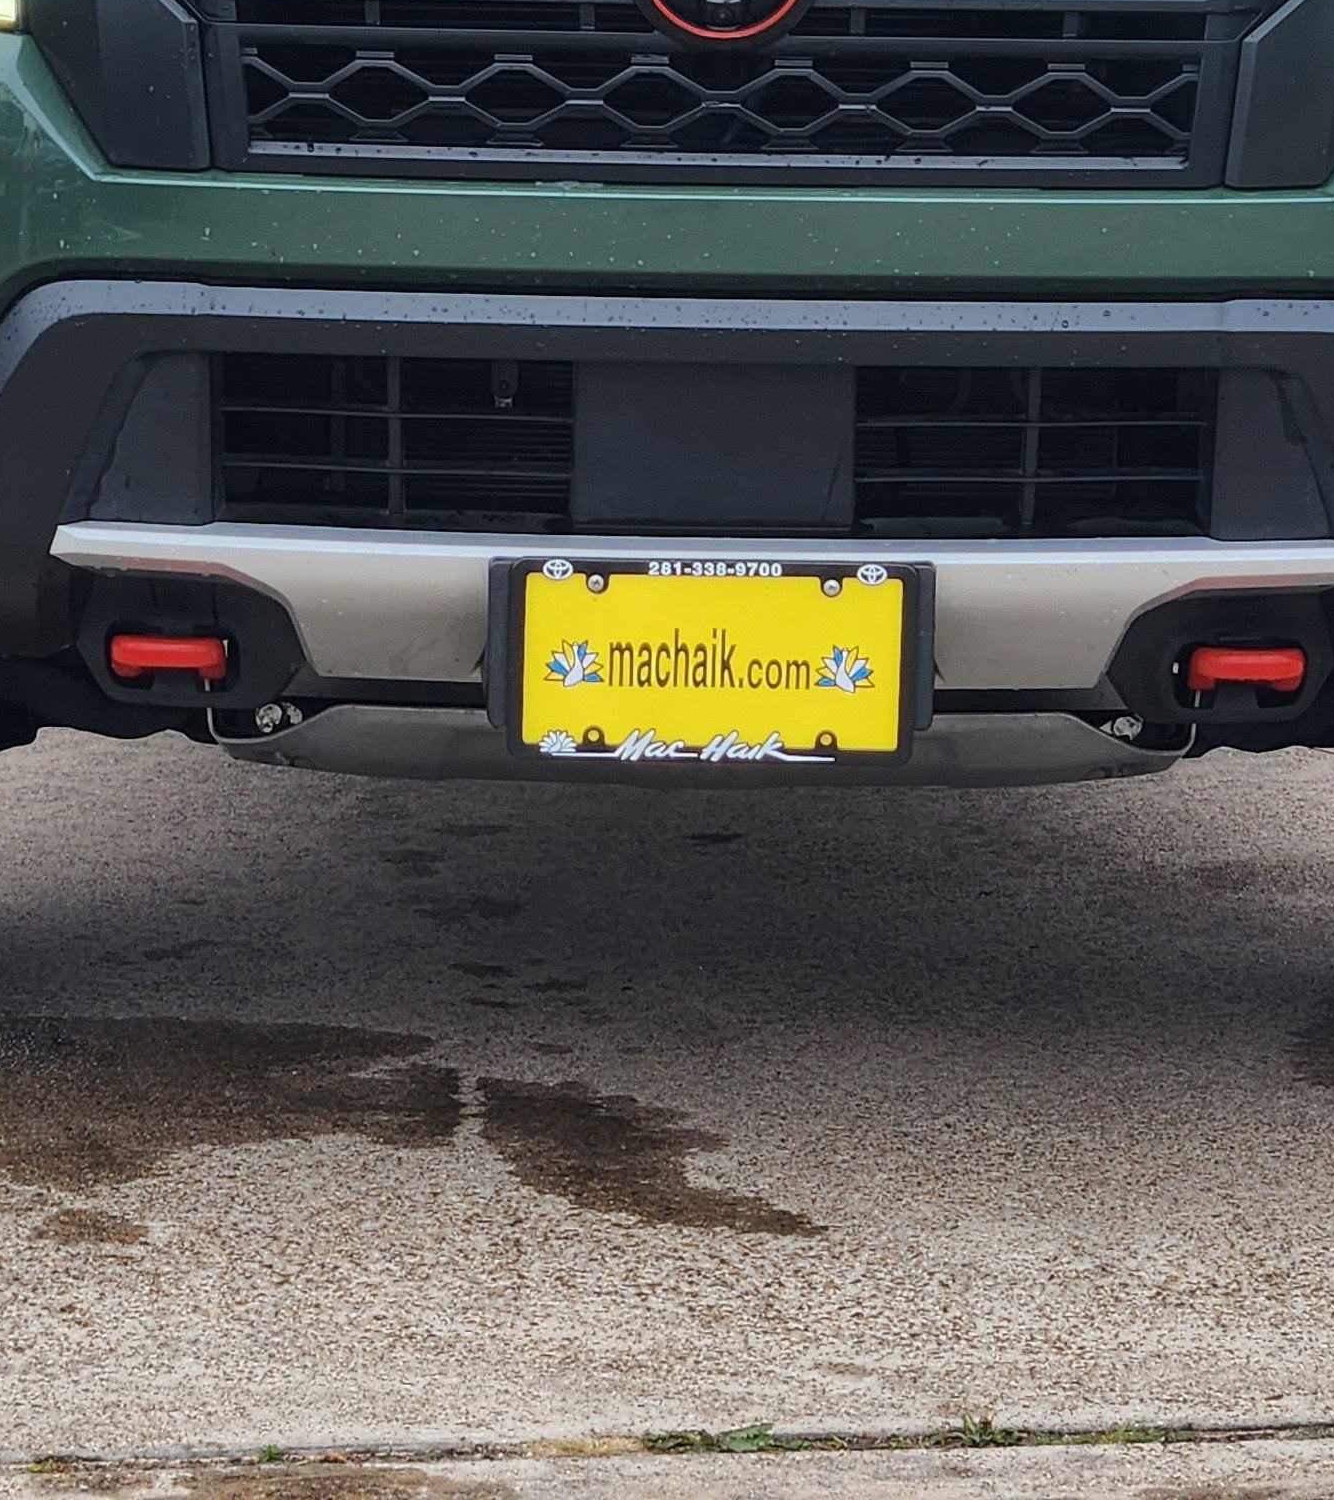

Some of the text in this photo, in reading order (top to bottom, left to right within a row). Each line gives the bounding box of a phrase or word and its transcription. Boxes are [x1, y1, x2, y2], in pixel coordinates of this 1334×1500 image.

[648, 560, 783, 577] 281-338-9700
[608, 627, 811, 691] machaik.com
[617, 729, 795, 762] Mac Haik
